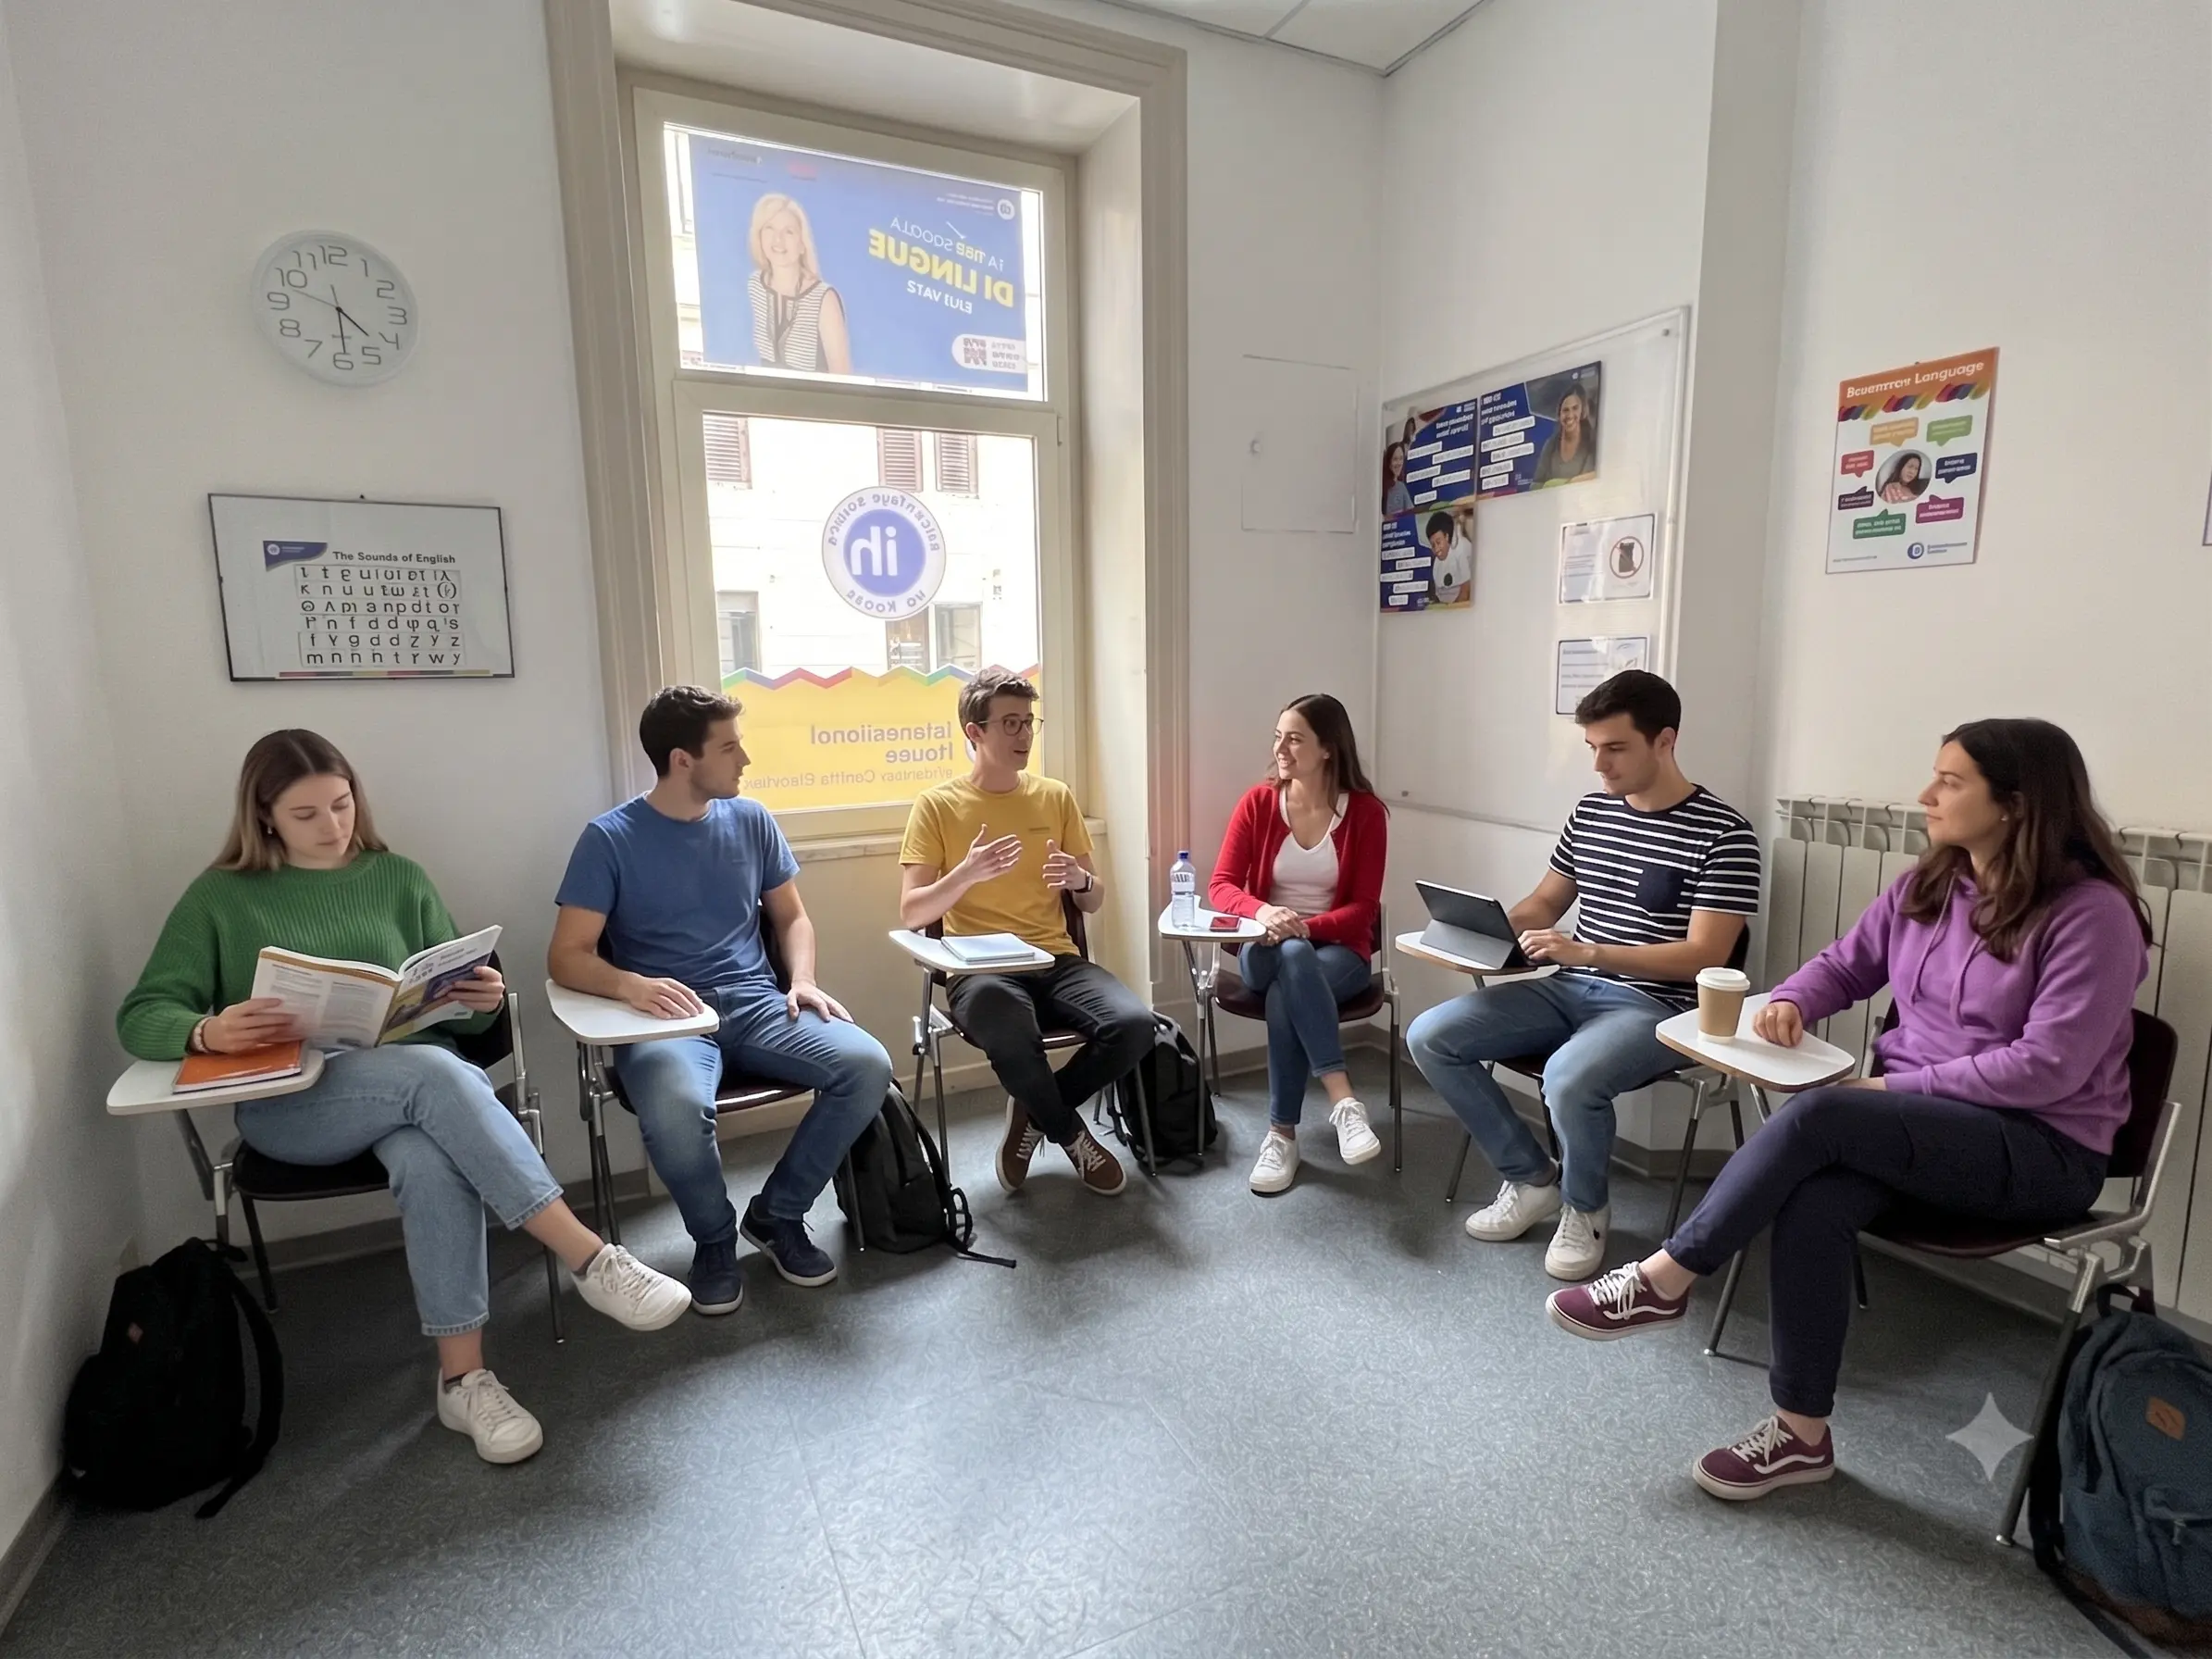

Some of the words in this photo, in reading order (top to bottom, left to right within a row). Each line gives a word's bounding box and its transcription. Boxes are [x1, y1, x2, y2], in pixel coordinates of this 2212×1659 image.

[292, 250, 317, 270] 11
[318, 244, 348, 267] 12
[360, 257, 369, 278] 1
[274, 267, 307, 289] 10
[376, 279, 395, 300] 2
[267, 291, 291, 311] 9
[387, 305, 408, 326] 3
[280, 318, 302, 338] 8
[304, 338, 324, 358] 7
[378, 331, 400, 350] 4
[332, 351, 354, 371] 6
[361, 345, 382, 366] 5
[1914, 360, 1984, 384] Language
[332, 551, 354, 561] The
[357, 552, 398, 562] Sounds
[403, 553, 413, 562] of
[416, 554, 455, 565] English
